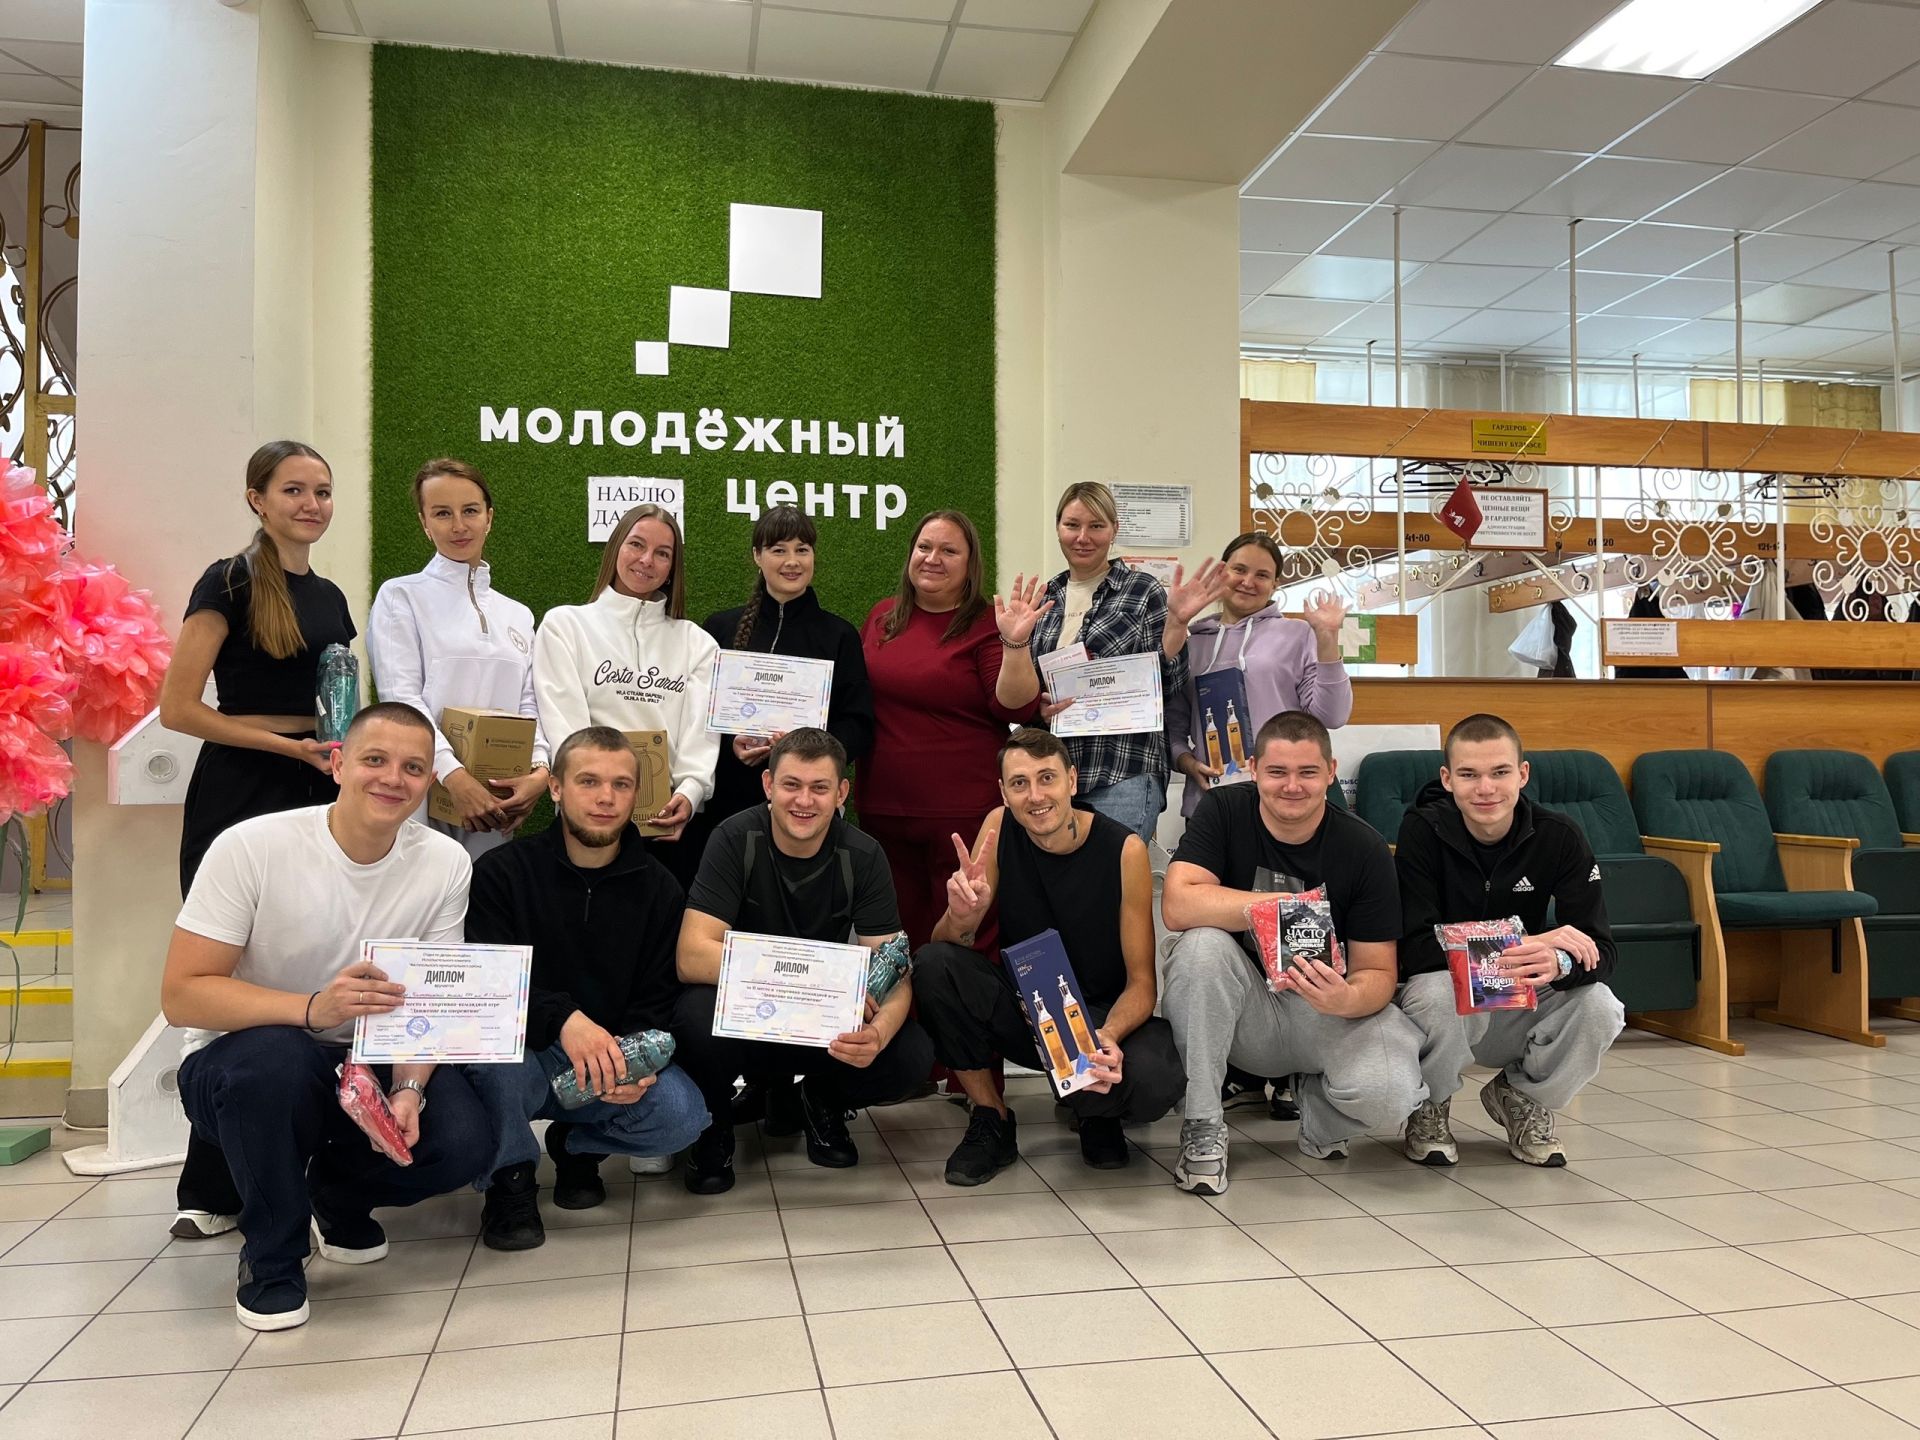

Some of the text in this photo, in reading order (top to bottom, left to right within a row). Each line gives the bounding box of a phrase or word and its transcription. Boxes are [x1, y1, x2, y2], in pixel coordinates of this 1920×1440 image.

[480, 406, 904, 457] молодёжный
[597, 486, 675, 503] НАБЛЮ
[727, 478, 907, 530] центр
[594, 659, 634, 686] Costa
[754, 671, 784, 683] ДИПЛОМ
[1089, 676, 1116, 688] ДИПЛОМ
[1286, 927, 1326, 939] ЧАСТО
[774, 961, 809, 974] ДИПЛОМ
[424, 970, 465, 984] ДИПЛОМ
